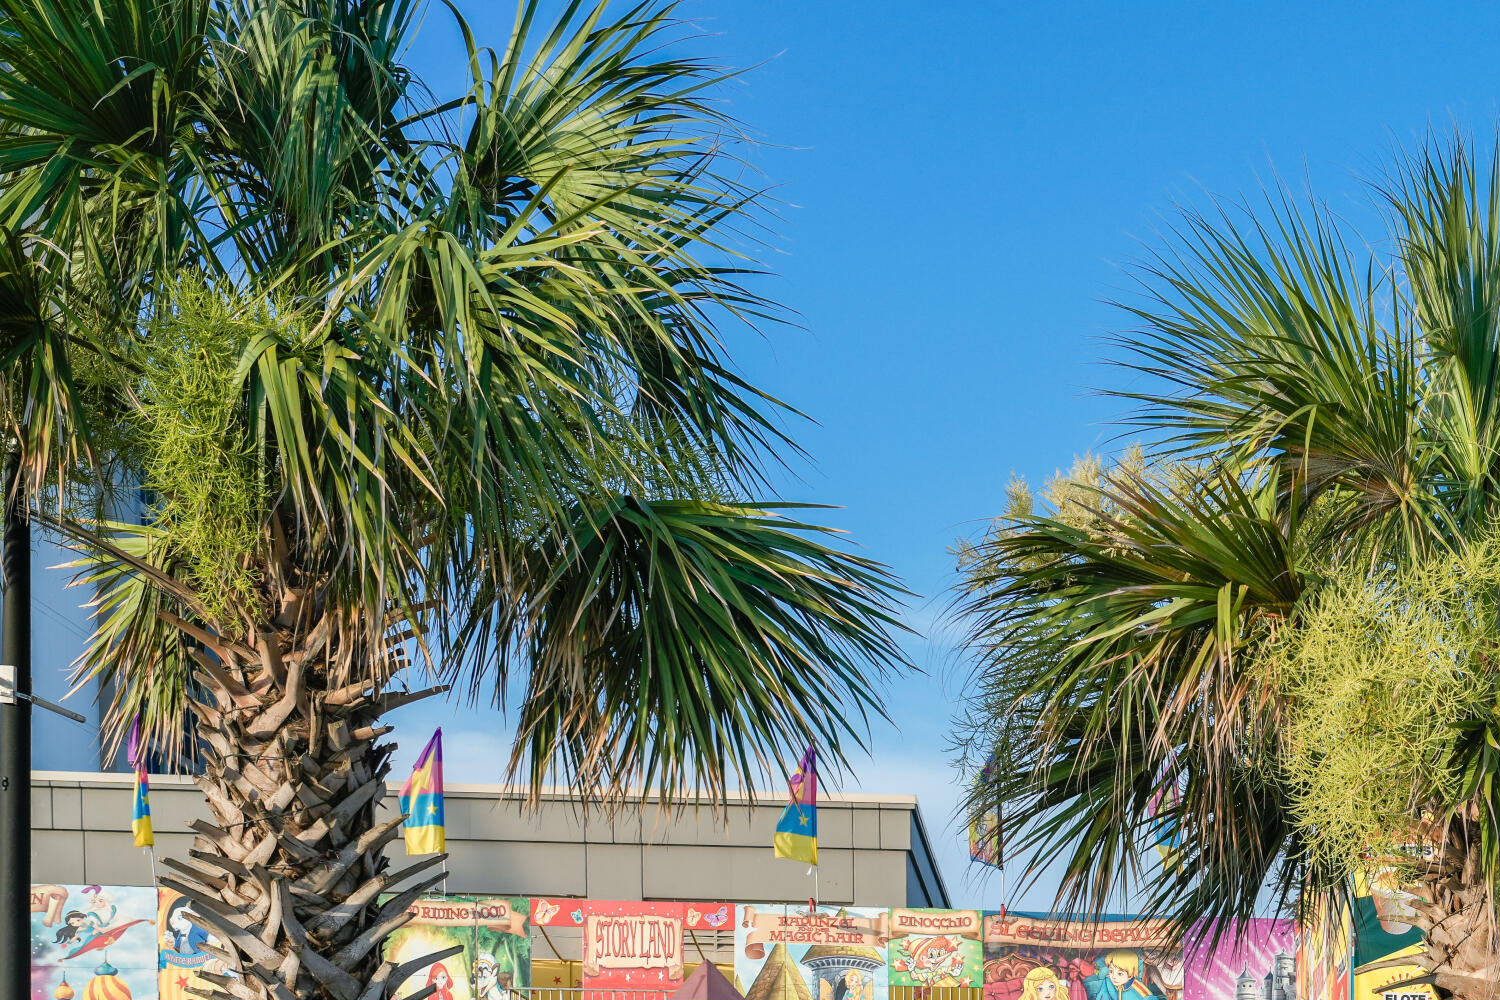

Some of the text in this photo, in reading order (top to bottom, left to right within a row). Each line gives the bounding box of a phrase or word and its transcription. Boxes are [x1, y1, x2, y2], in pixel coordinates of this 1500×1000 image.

[420, 907, 470, 921] RIDING
[472, 903, 505, 920] HOOD
[778, 916, 858, 930] RAPUNZEL
[898, 915, 972, 929] PINOCCHIO
[769, 930, 865, 944] MAGIC HAIR
